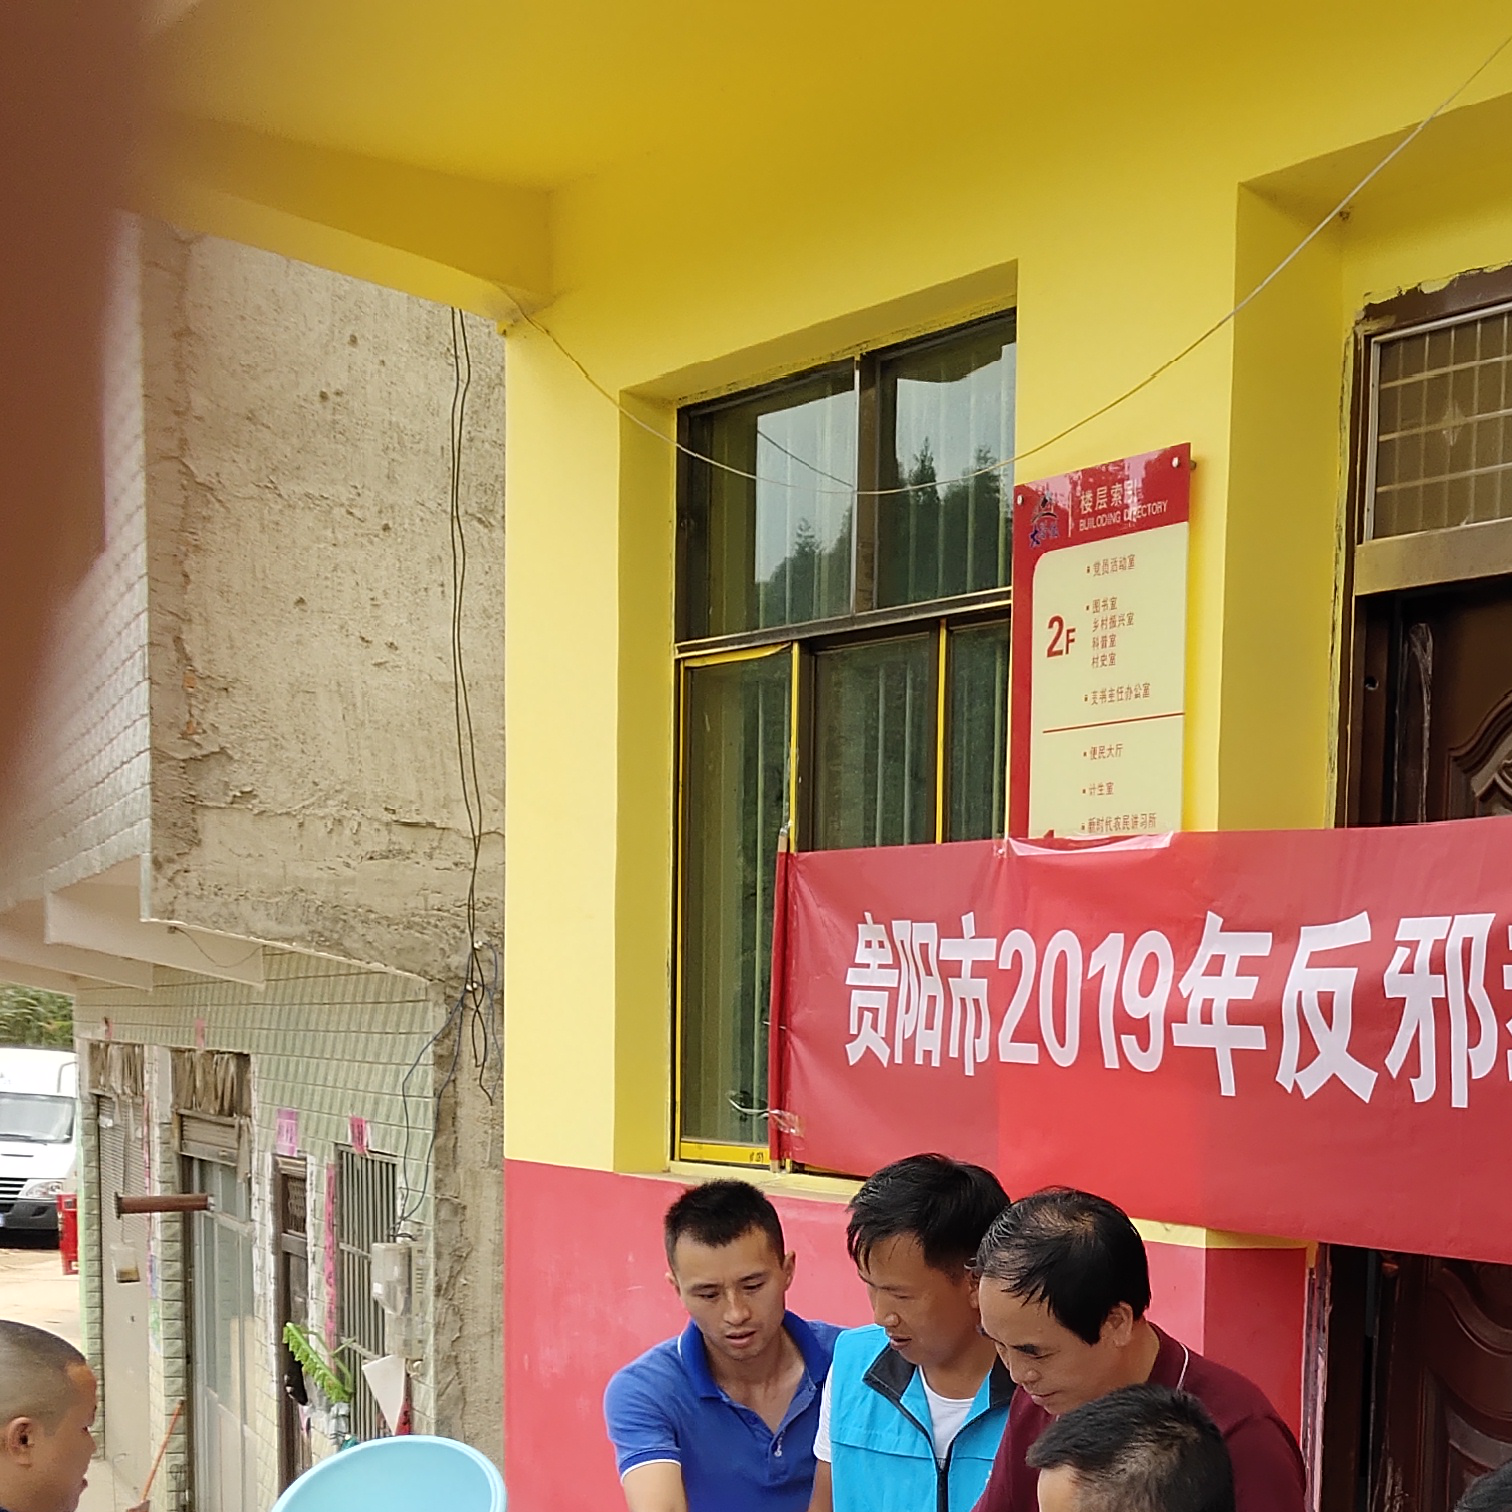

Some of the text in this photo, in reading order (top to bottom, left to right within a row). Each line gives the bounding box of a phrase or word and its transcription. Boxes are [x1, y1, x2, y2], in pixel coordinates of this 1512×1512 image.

[1080, 480, 1138, 515] 楼层索引
[1123, 500, 1168, 522] DIRECTORY
[1092, 553, 1136, 577] 党员活动室
[1092, 596, 1118, 613] 图书室
[1092, 612, 1134, 632] 乡村振兴室
[1046, 615, 1076, 659] 2F
[1089, 743, 1123, 762] 便民大厅
[1088, 782, 1115, 798] 计生室
[1088, 812, 1157, 833] 新时代农民讲习所
